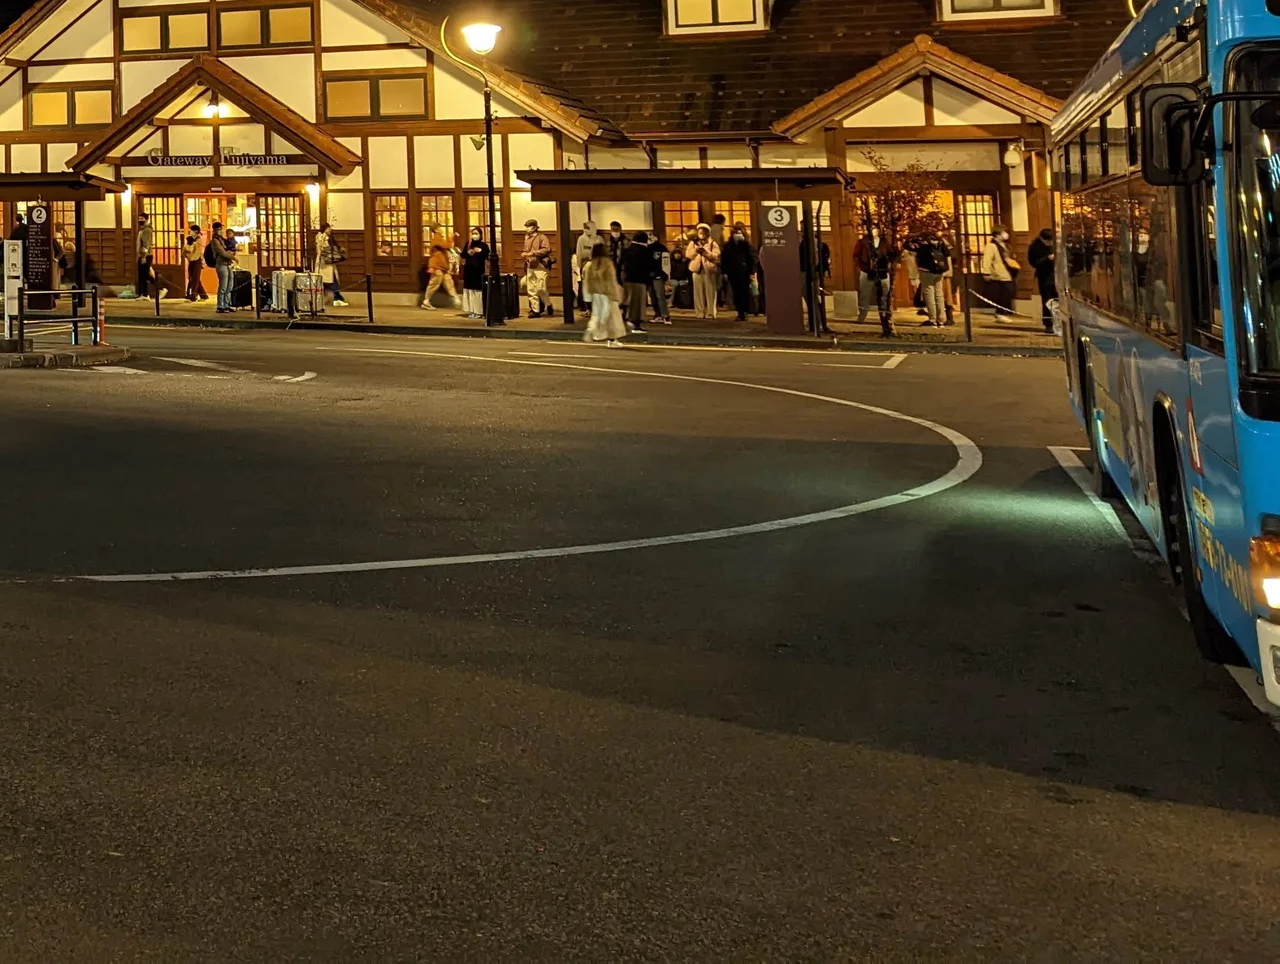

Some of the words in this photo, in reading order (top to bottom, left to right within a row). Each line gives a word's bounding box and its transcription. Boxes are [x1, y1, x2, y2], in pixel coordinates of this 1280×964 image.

[148, 148, 211, 166] Gateway
[218, 147, 288, 166] Fujiyama
[36, 209, 42, 219] 2
[774, 209, 784, 222] 3
